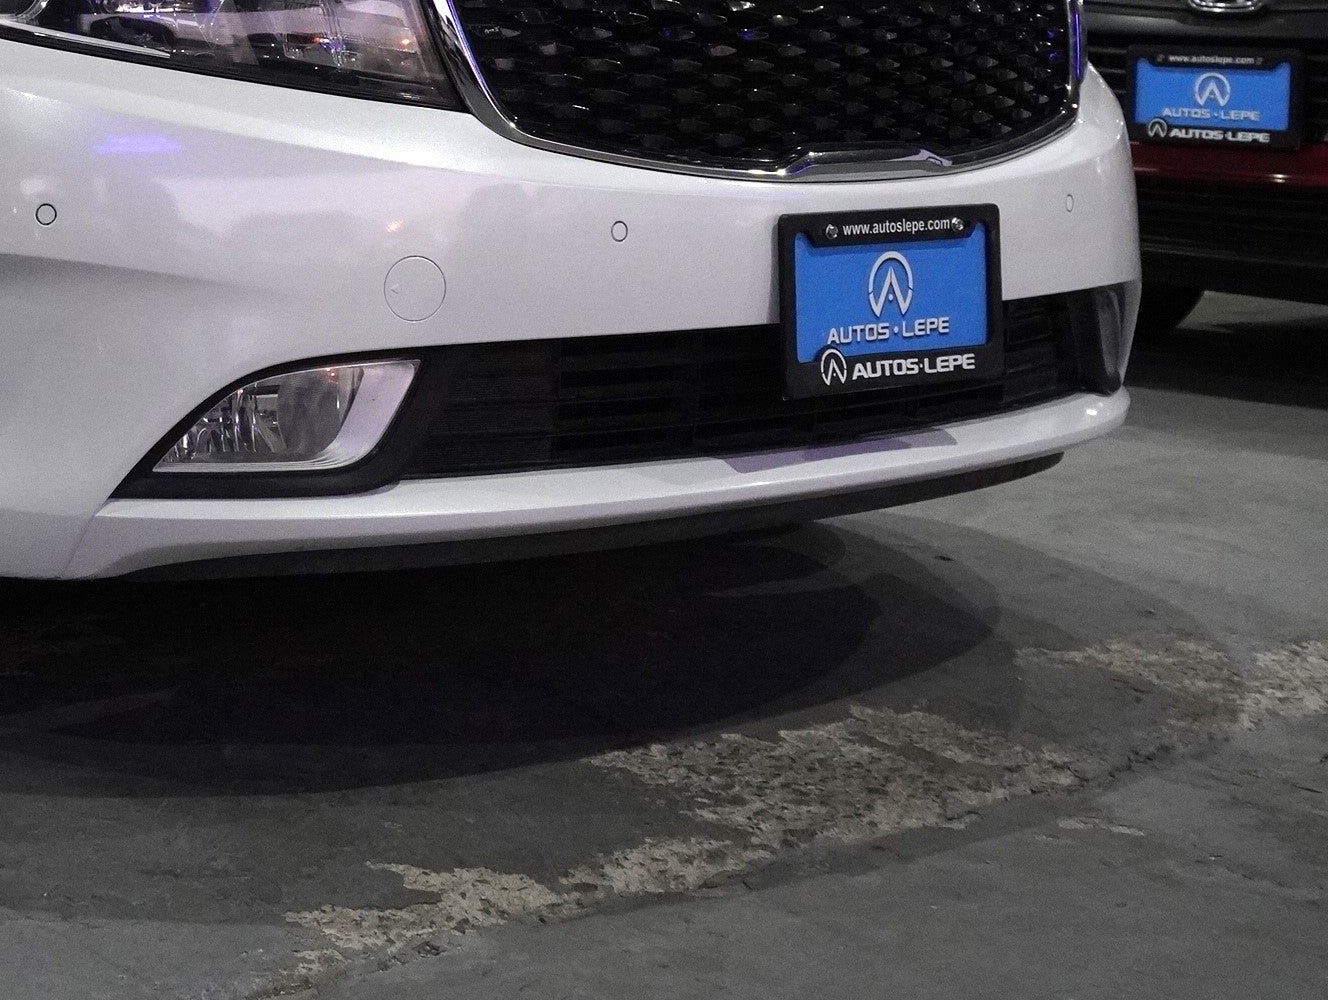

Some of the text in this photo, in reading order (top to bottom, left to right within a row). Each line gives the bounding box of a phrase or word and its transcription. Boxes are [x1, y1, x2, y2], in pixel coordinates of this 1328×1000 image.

[1161, 107, 1261, 122] AUTOS LEPE
[842, 217, 951, 237] www.autoslepe.com
[826, 316, 950, 345] AUTOS LEPE
